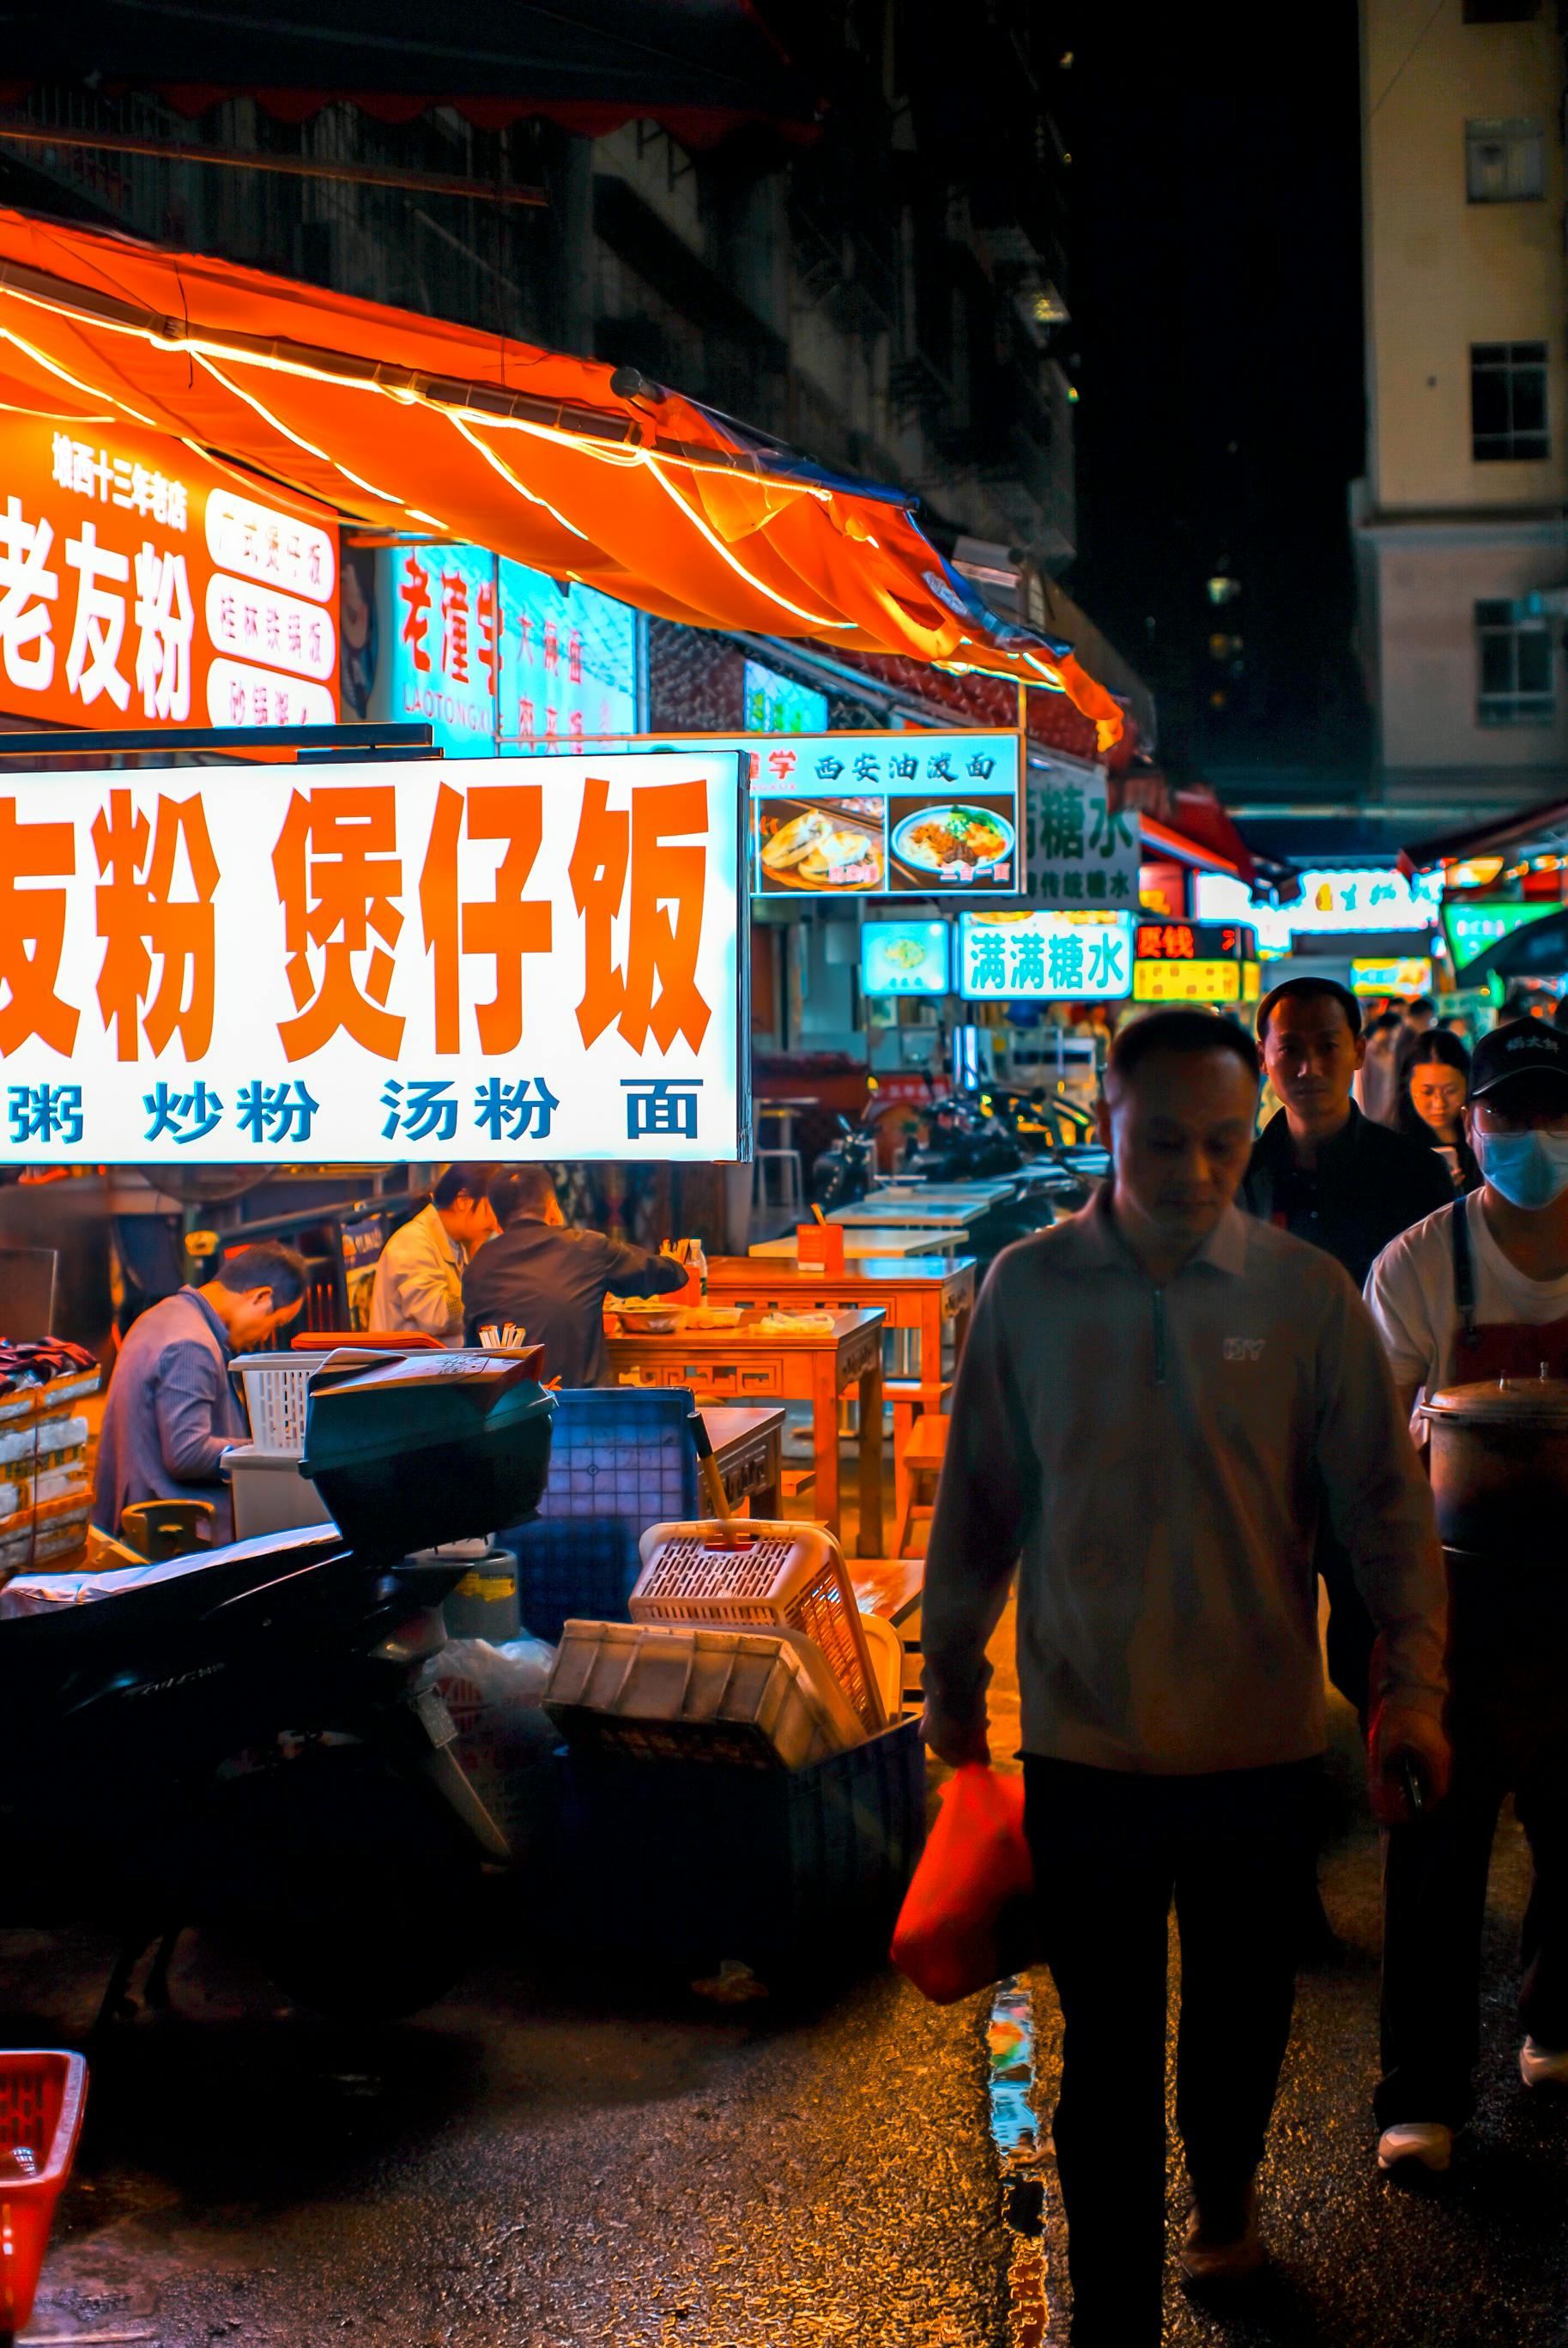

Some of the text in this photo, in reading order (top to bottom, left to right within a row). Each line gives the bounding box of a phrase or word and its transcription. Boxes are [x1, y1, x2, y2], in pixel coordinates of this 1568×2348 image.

[0, 495, 194, 722] 老友粉
[1027, 782, 1134, 859] 糖水
[271, 778, 712, 1063] 煲仔饭
[970, 932, 1126, 989] 满满糖水
[7, 1077, 704, 1144] 粥 炒粉 汤粉 面
